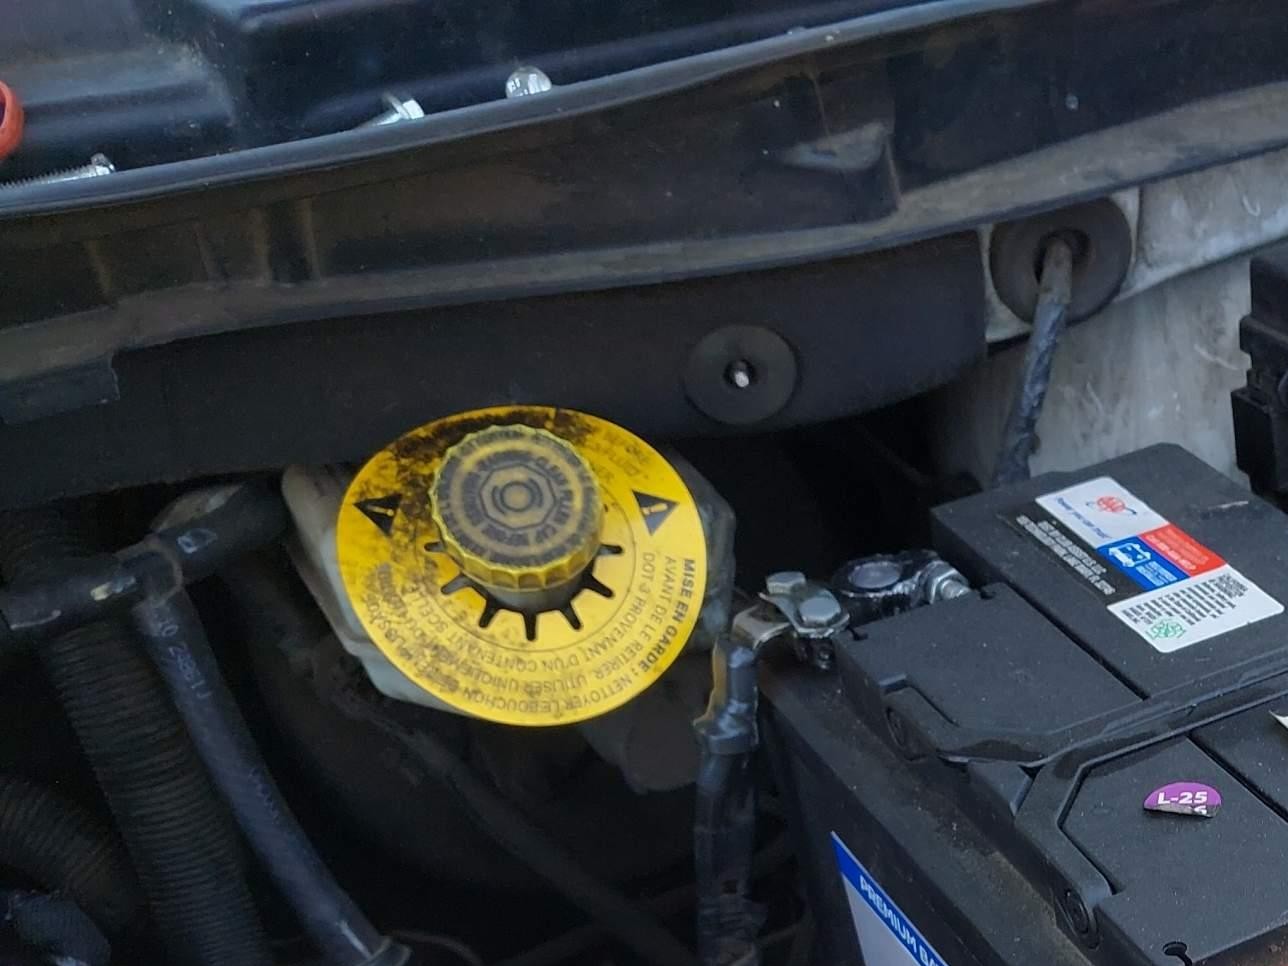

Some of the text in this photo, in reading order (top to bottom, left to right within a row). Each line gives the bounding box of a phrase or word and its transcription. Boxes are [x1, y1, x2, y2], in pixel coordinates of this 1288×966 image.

[640, 551, 654, 584] DOT
[660, 556, 676, 598] AVANT
[679, 558, 695, 602] MISE
[672, 603, 686, 626] EN
[637, 624, 676, 670] GARDE
[1158, 791, 1208, 804] L-25
[860, 875, 917, 953] PREMIUM
